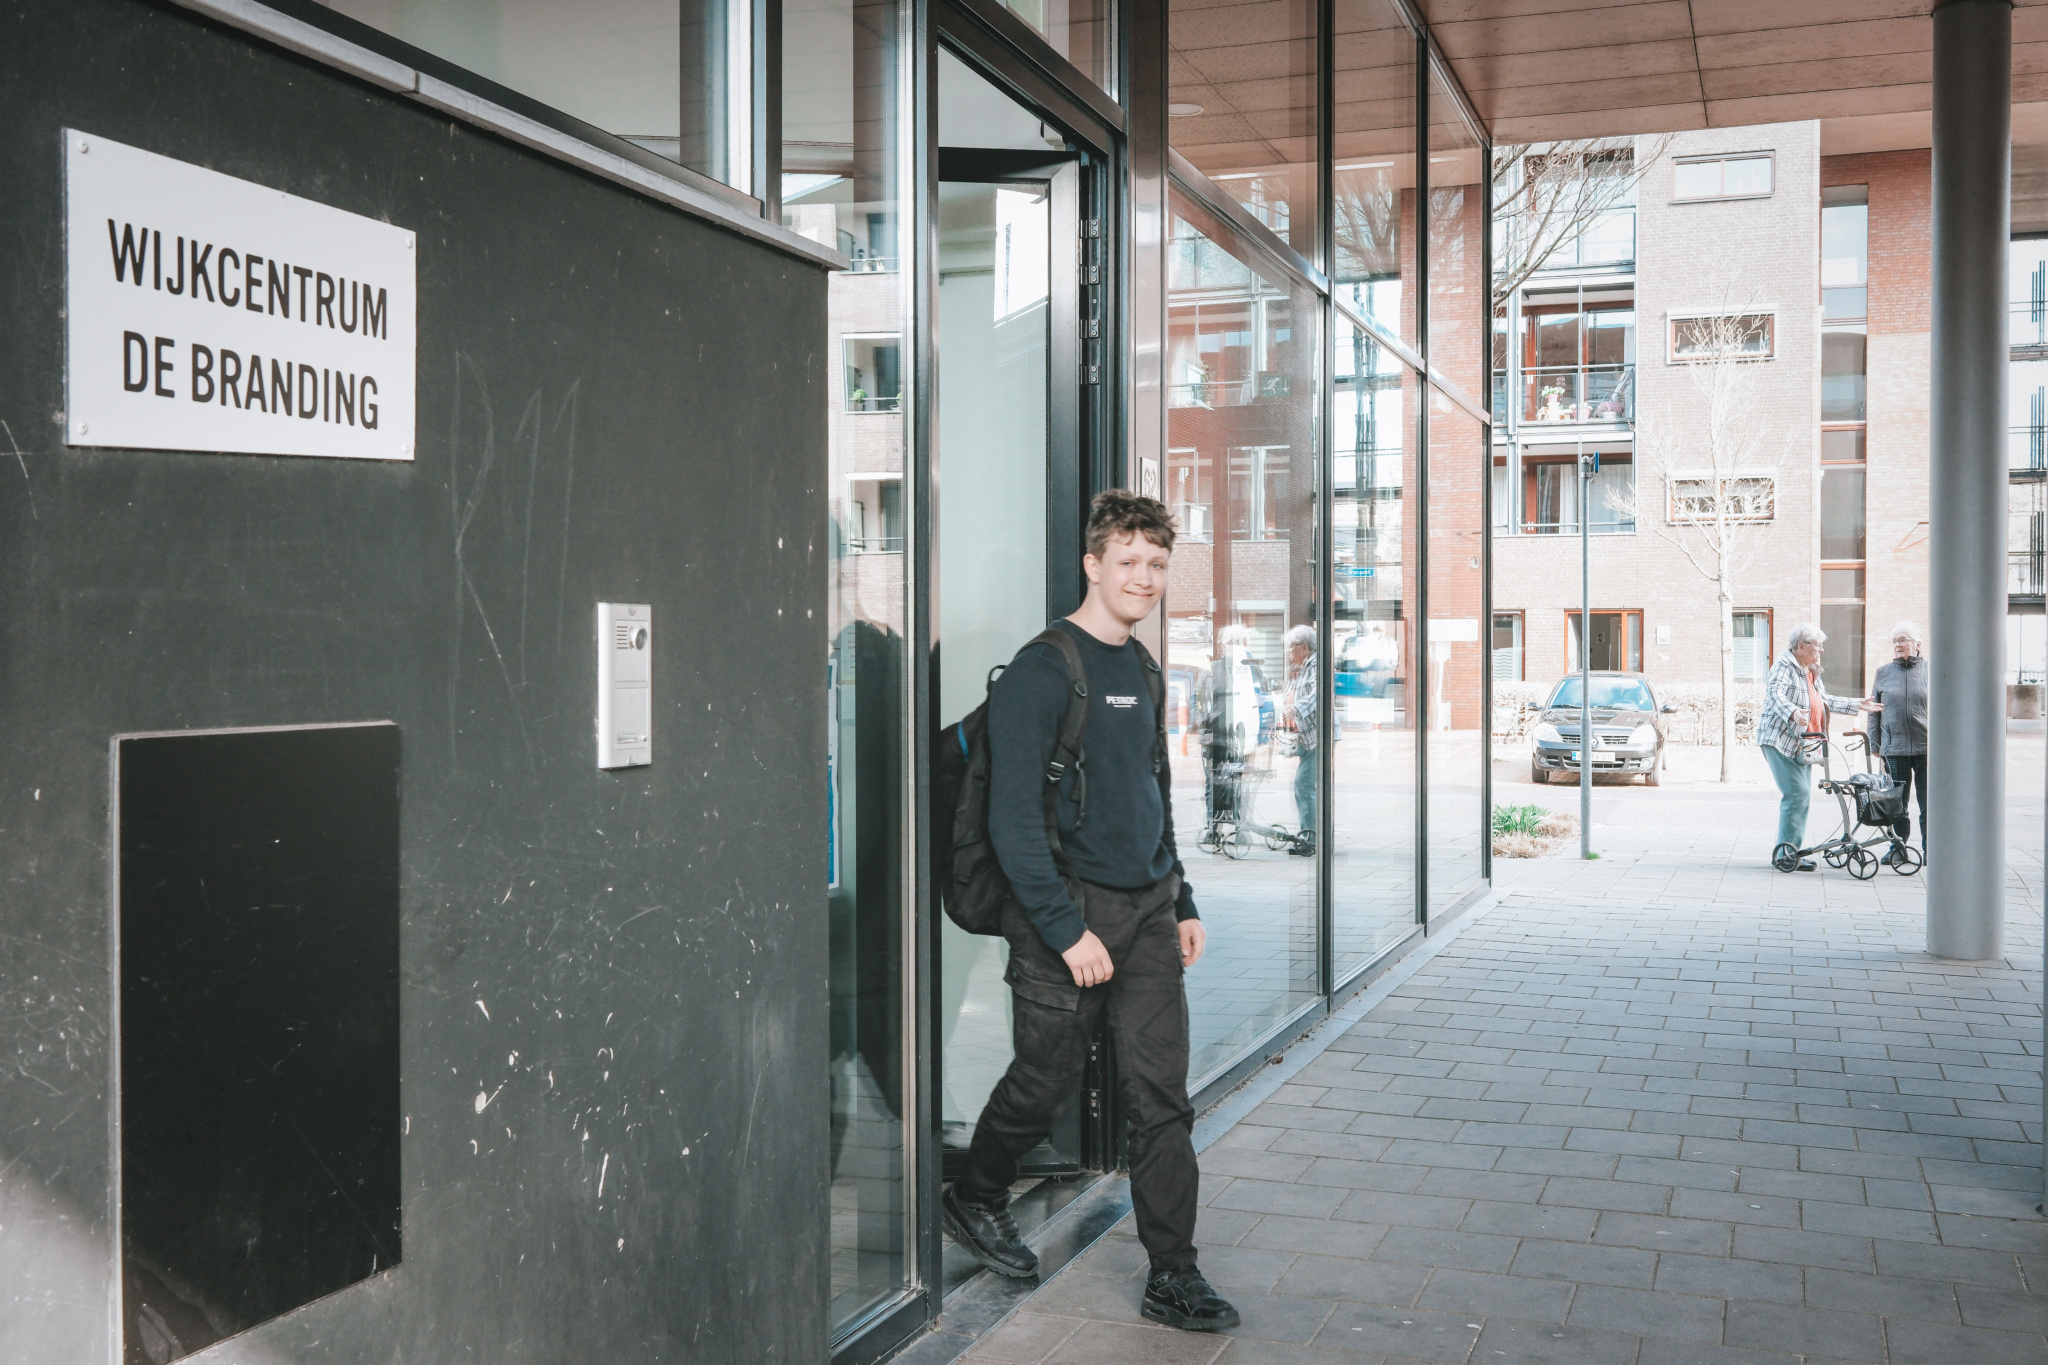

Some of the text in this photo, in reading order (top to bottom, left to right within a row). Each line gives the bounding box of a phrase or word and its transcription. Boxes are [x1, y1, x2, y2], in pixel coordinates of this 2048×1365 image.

[108, 218, 387, 340] WIJKCENTRUM
[123, 330, 379, 430] DE BRANDING
